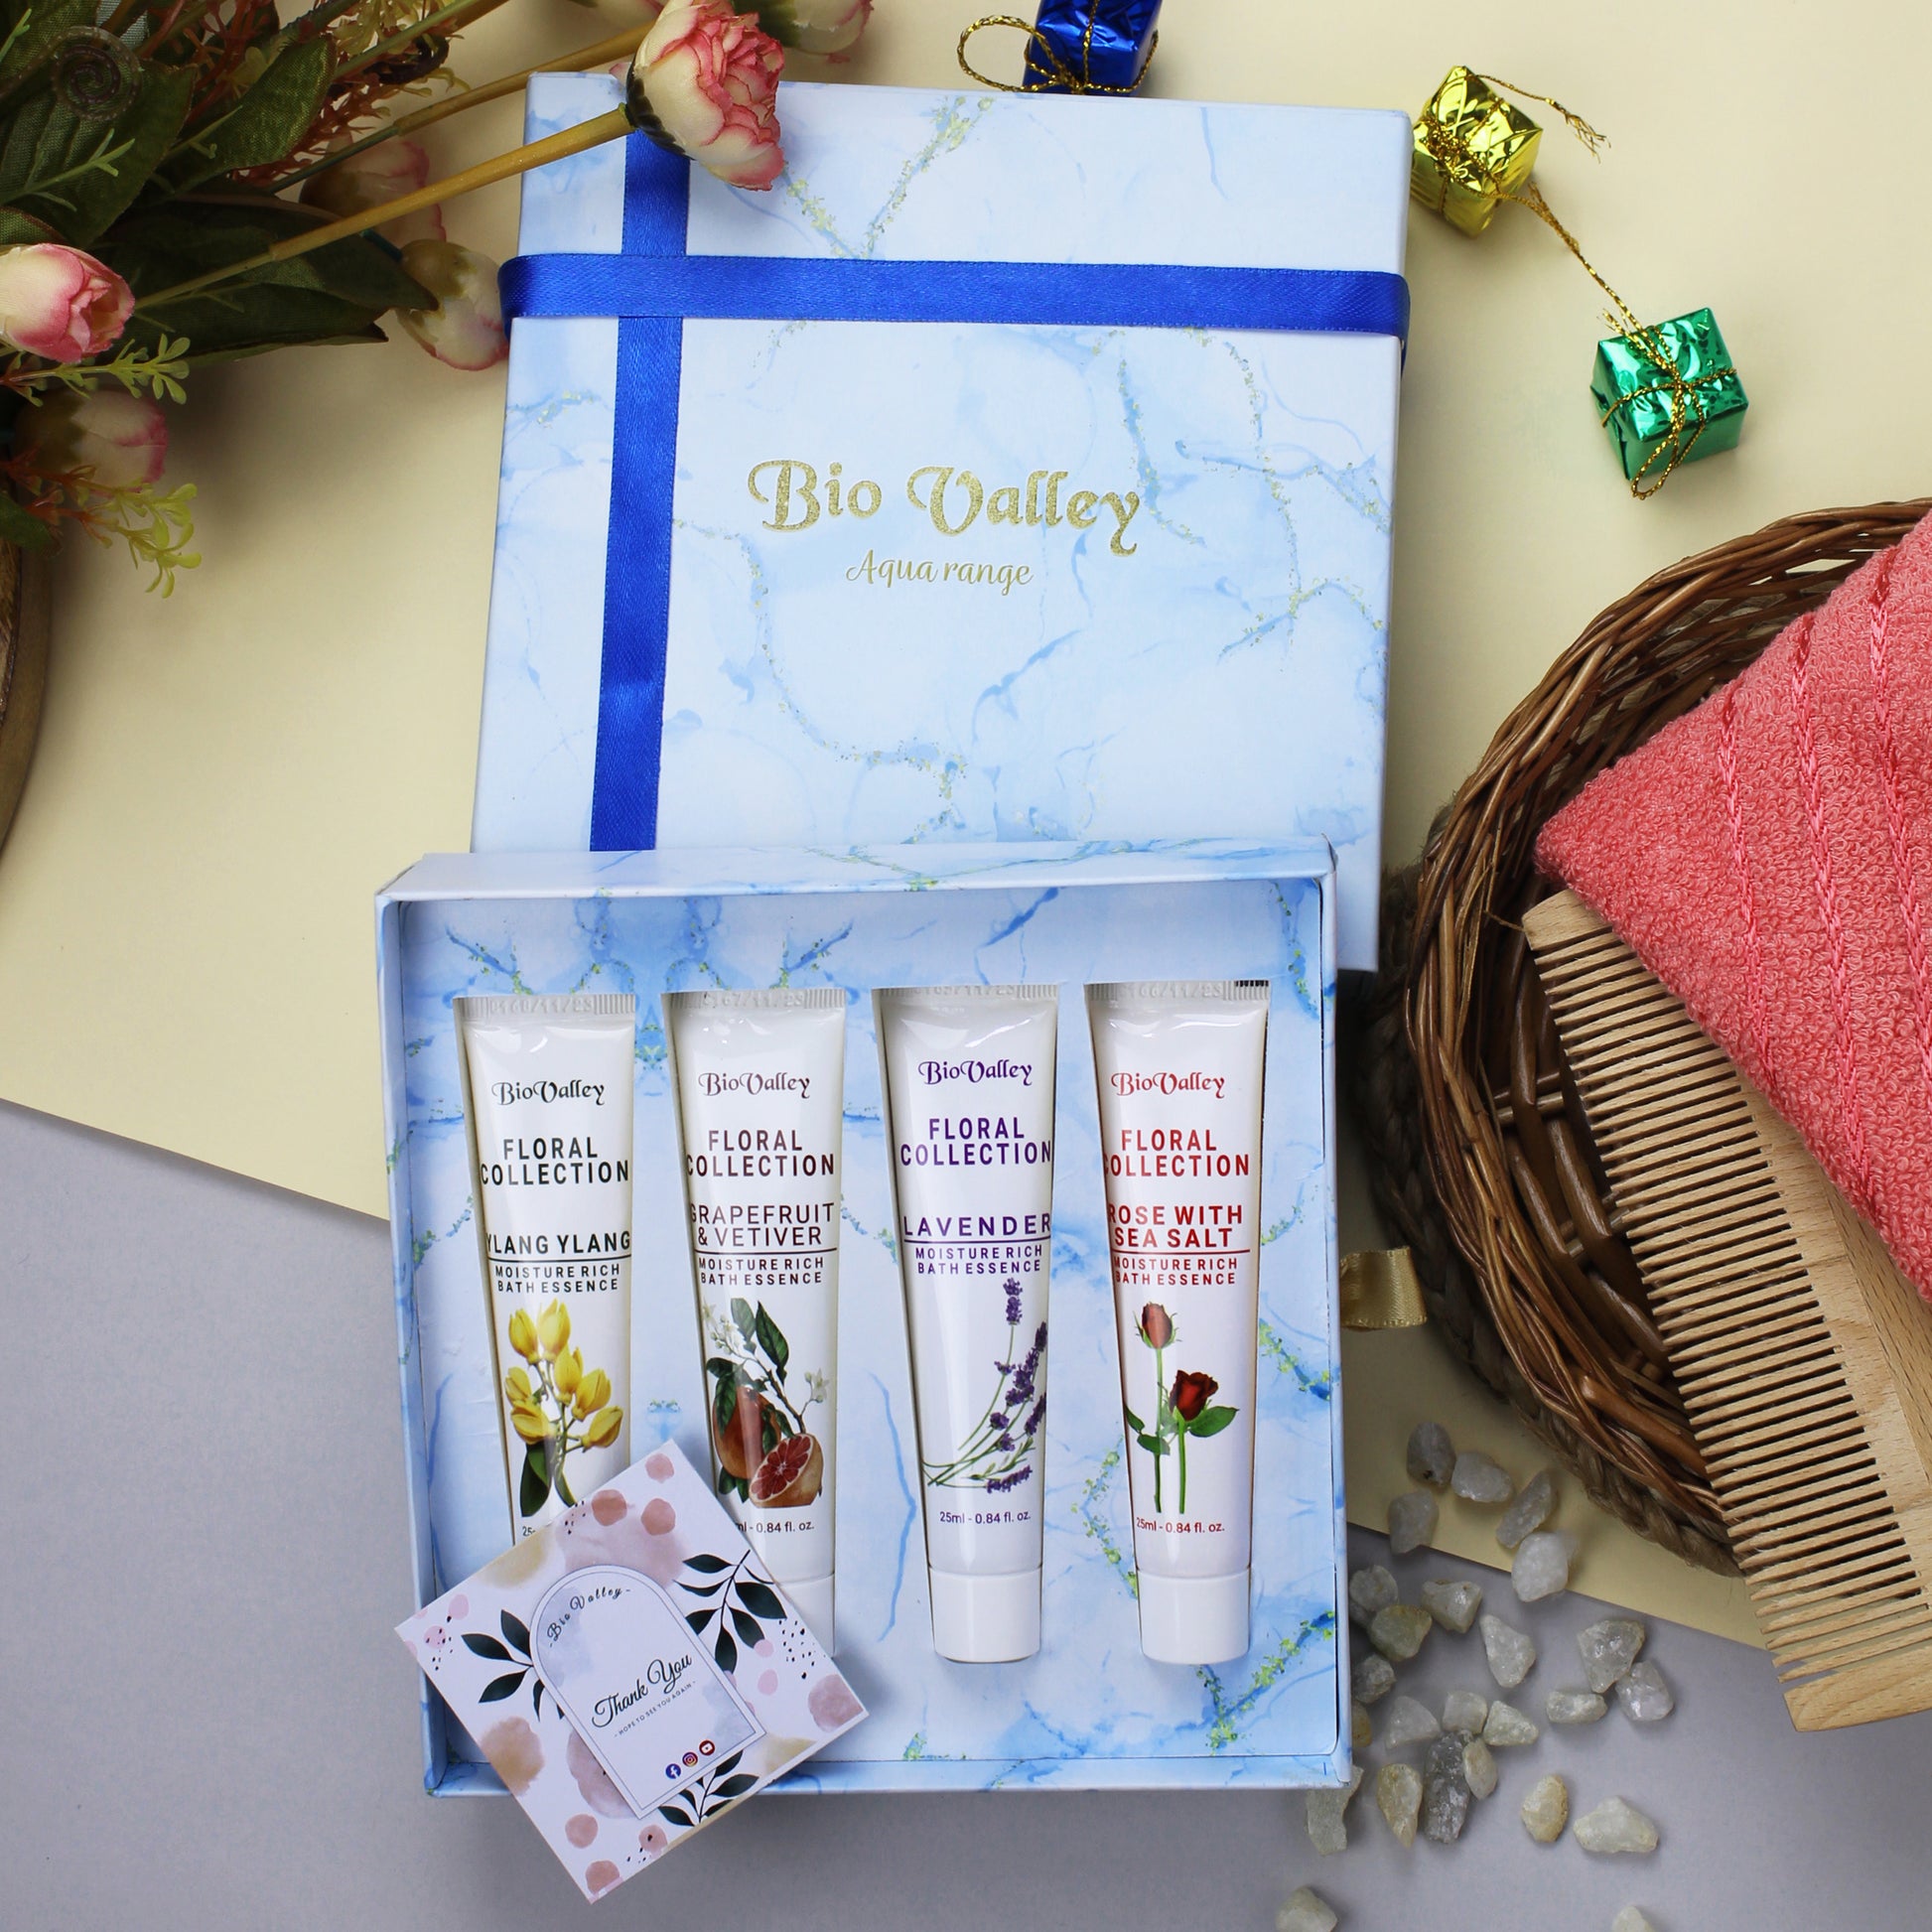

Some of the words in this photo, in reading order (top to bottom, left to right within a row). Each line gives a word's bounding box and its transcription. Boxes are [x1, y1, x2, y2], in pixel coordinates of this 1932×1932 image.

[748, 459, 882, 532] Bio
[906, 465, 1141, 557] Valley
[846, 549, 937, 589] Aqua
[942, 560, 1035, 597] range
[917, 1059, 1033, 1086] BioValley
[491, 1079, 605, 1106] BioValley
[698, 1072, 810, 1099] BioValley
[1111, 1072, 1225, 1099] BioValley
[929, 1117, 1025, 1140] FLORAL
[503, 1137, 598, 1161] FLORAL
[708, 1129, 802, 1152] FLORAL
[1122, 1129, 1217, 1152] FLORAL
[686, 1154, 834, 1176] COLLECTION
[900, 1140, 1050, 1167] COLLECTION
[481, 1160, 628, 1186] COLLECTION
[903, 1213, 1050, 1237] LAVENDER
[1108, 1203, 1165, 1225] ROSE
[1174, 1204, 1242, 1225] WITH
[486, 1233, 548, 1255] YLANG
[557, 1230, 630, 1254] YLANG
[698, 1226, 708, 1246] &
[715, 1226, 822, 1247] VETIVER
[1115, 1227, 1158, 1248] SEA
[1167, 1228, 1232, 1248] SALT
[915, 1246, 1000, 1260] MOISTURE
[1006, 1244, 1042, 1259] RICH
[1114, 1256, 1190, 1271] MOISTURE
[1197, 1257, 1237, 1271] RICH
[495, 1265, 575, 1279] MOISTURE
[581, 1263, 620, 1277] RICH
[699, 1257, 777, 1271] MOISTURE
[784, 1257, 824, 1271] RICH
[918, 1262, 959, 1275] BATH
[965, 1260, 1040, 1275] ESSENCE
[497, 1280, 535, 1294] BATH
[541, 1278, 619, 1294] ESSENCE
[701, 1272, 738, 1286] BATH
[745, 1272, 822, 1286] ESSENCE
[1115, 1271, 1150, 1285] BATH
[1158, 1272, 1235, 1286] ESSENCE
[756, 1522, 781, 1533] 0.84
[784, 1520, 795, 1532] fl.
[798, 1521, 814, 1531] oz.
[939, 1511, 965, 1524] 25ml
[975, 1512, 1001, 1524] 0.84
[1003, 1511, 1015, 1523] fl.
[1017, 1511, 1032, 1522] oz.
[1137, 1517, 1158, 1533] 25ml
[1166, 1521, 1190, 1534] 0.84
[1193, 1521, 1205, 1533] fl.
[1208, 1522, 1225, 1533] oz.
[521, 1525, 536, 1537] 25
[547, 1613, 571, 1641] Bio
[592, 1679, 648, 1728] Thank
[647, 1654, 693, 1695] You
[619, 1721, 635, 1735] HOPE
[635, 1715, 645, 1724] TO
[645, 1707, 657, 1718] SEE
[657, 1697, 671, 1709] YOU
[672, 1683, 692, 1699] AGAIN
